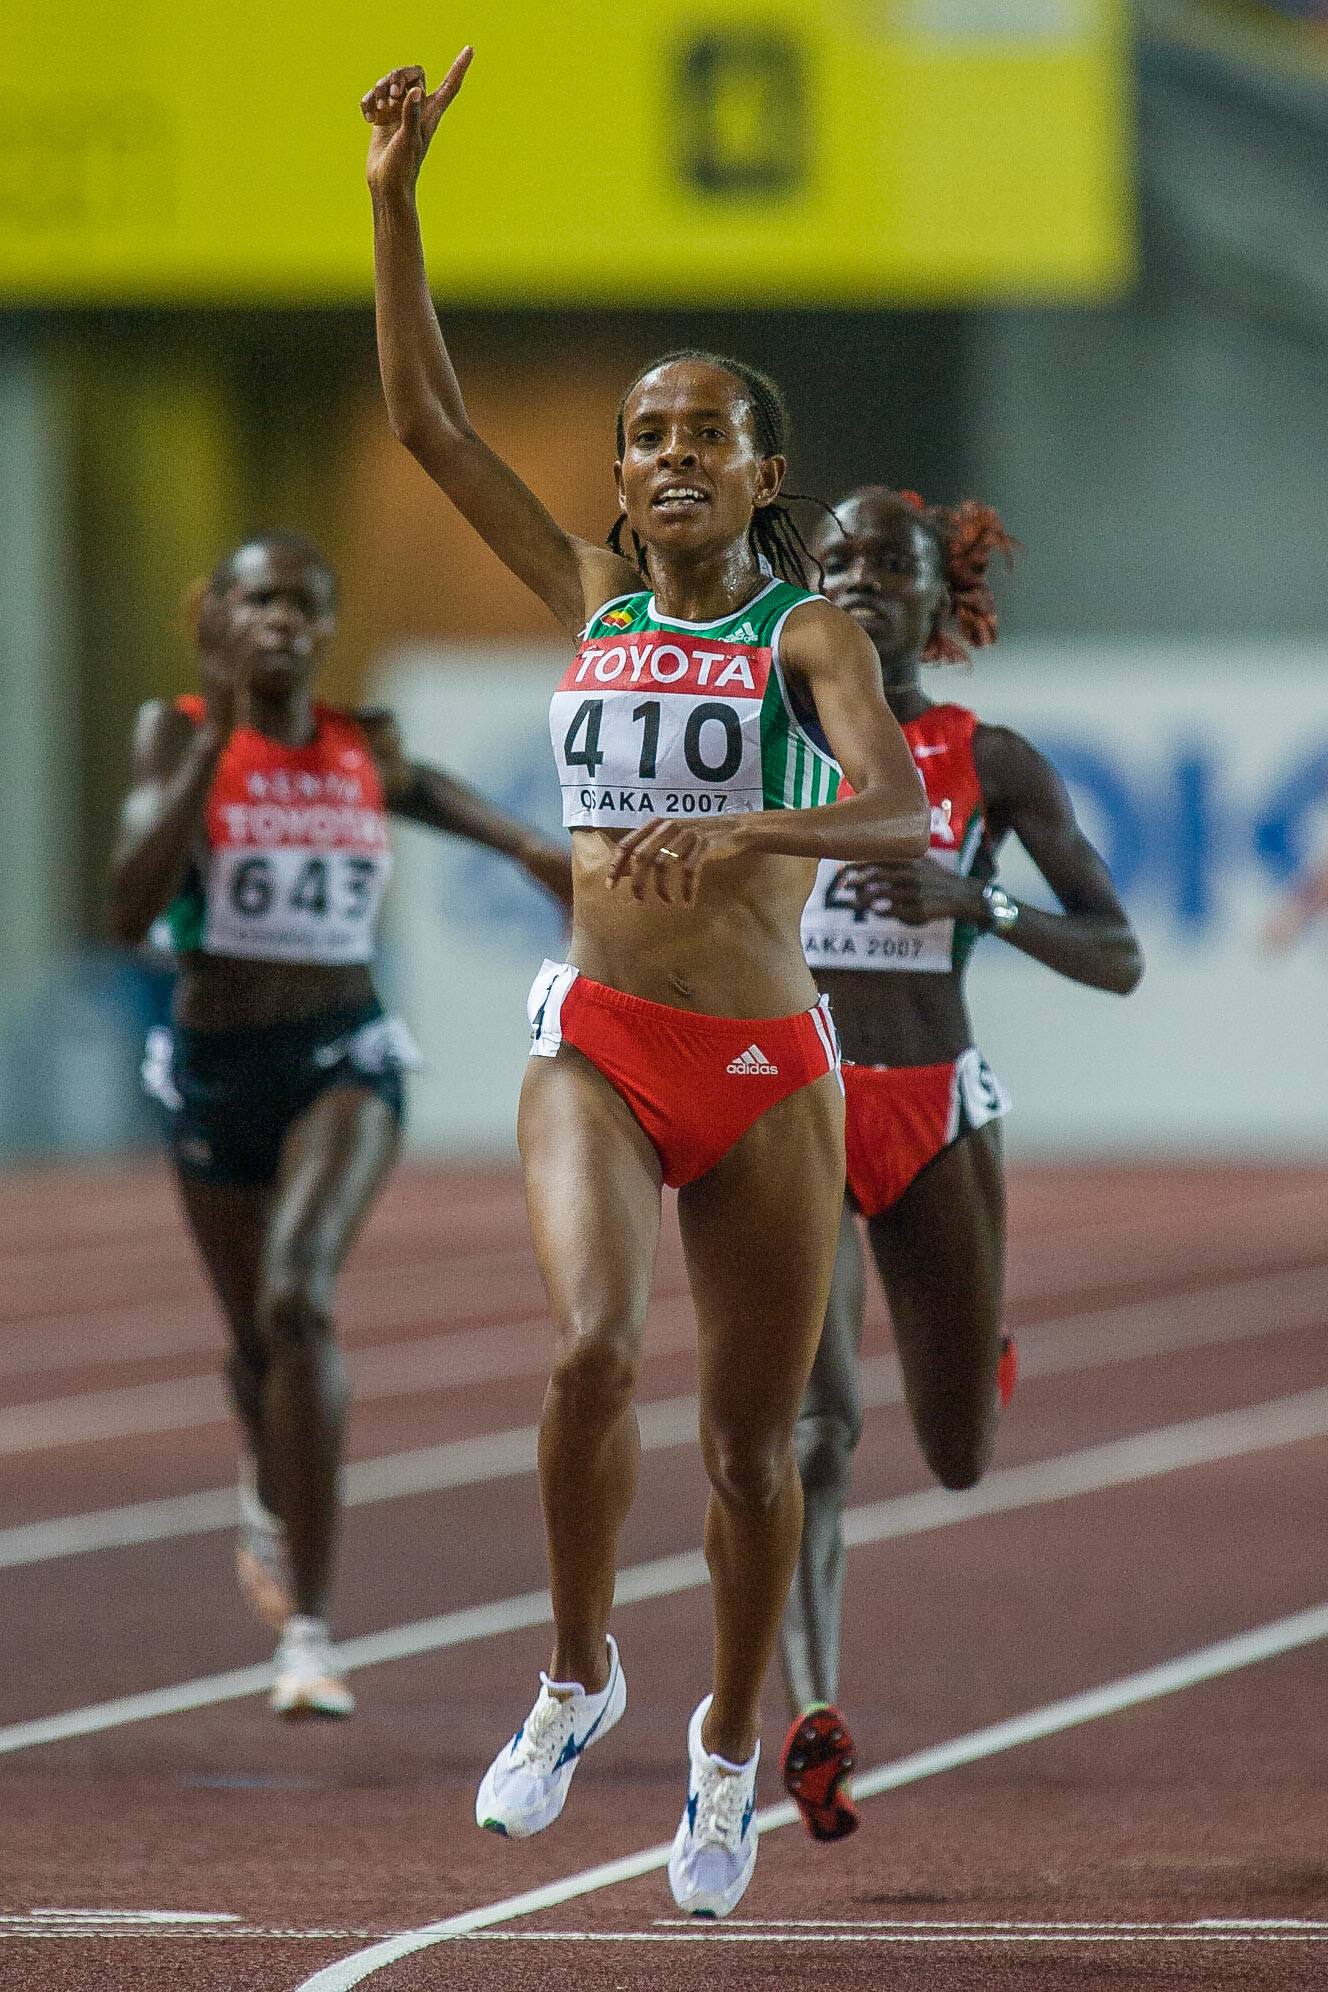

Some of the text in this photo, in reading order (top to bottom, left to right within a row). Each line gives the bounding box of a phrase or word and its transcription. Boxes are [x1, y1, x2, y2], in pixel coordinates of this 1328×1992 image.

[575, 644, 757, 690] TOYOTA
[563, 698, 744, 783] 410
[665, 793, 728, 813] 2007
[232, 857, 377, 918] 643
[726, 1062, 779, 1075] adidas
